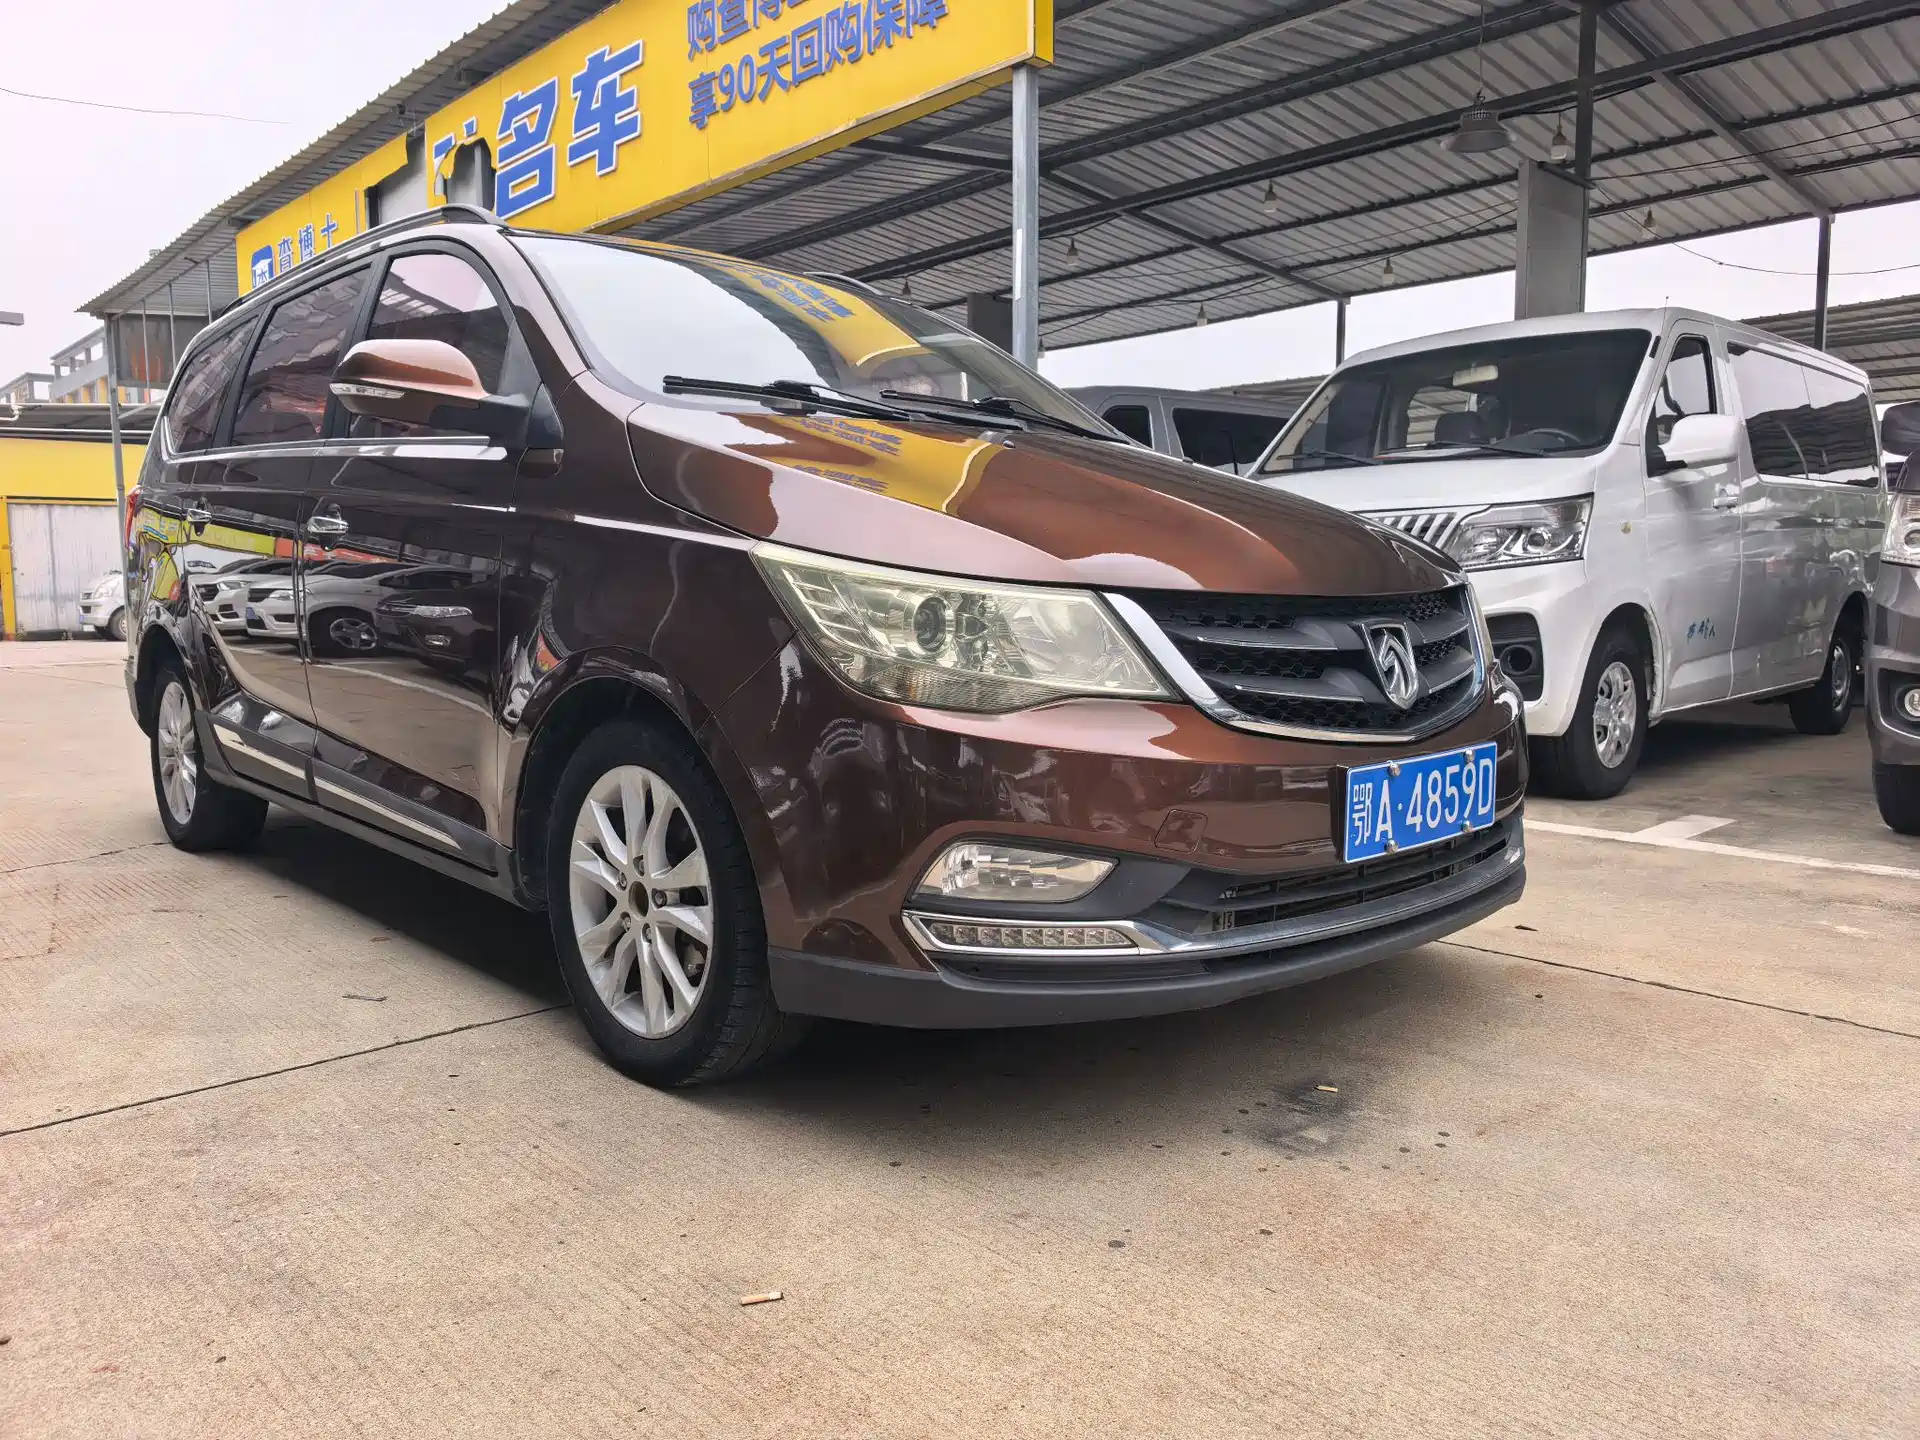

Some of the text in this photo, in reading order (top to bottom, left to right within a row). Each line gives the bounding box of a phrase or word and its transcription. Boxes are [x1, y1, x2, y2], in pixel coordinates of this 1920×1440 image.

[433, 39, 643, 220] 名车
[688, 0, 949, 129] 享90天回购保障
